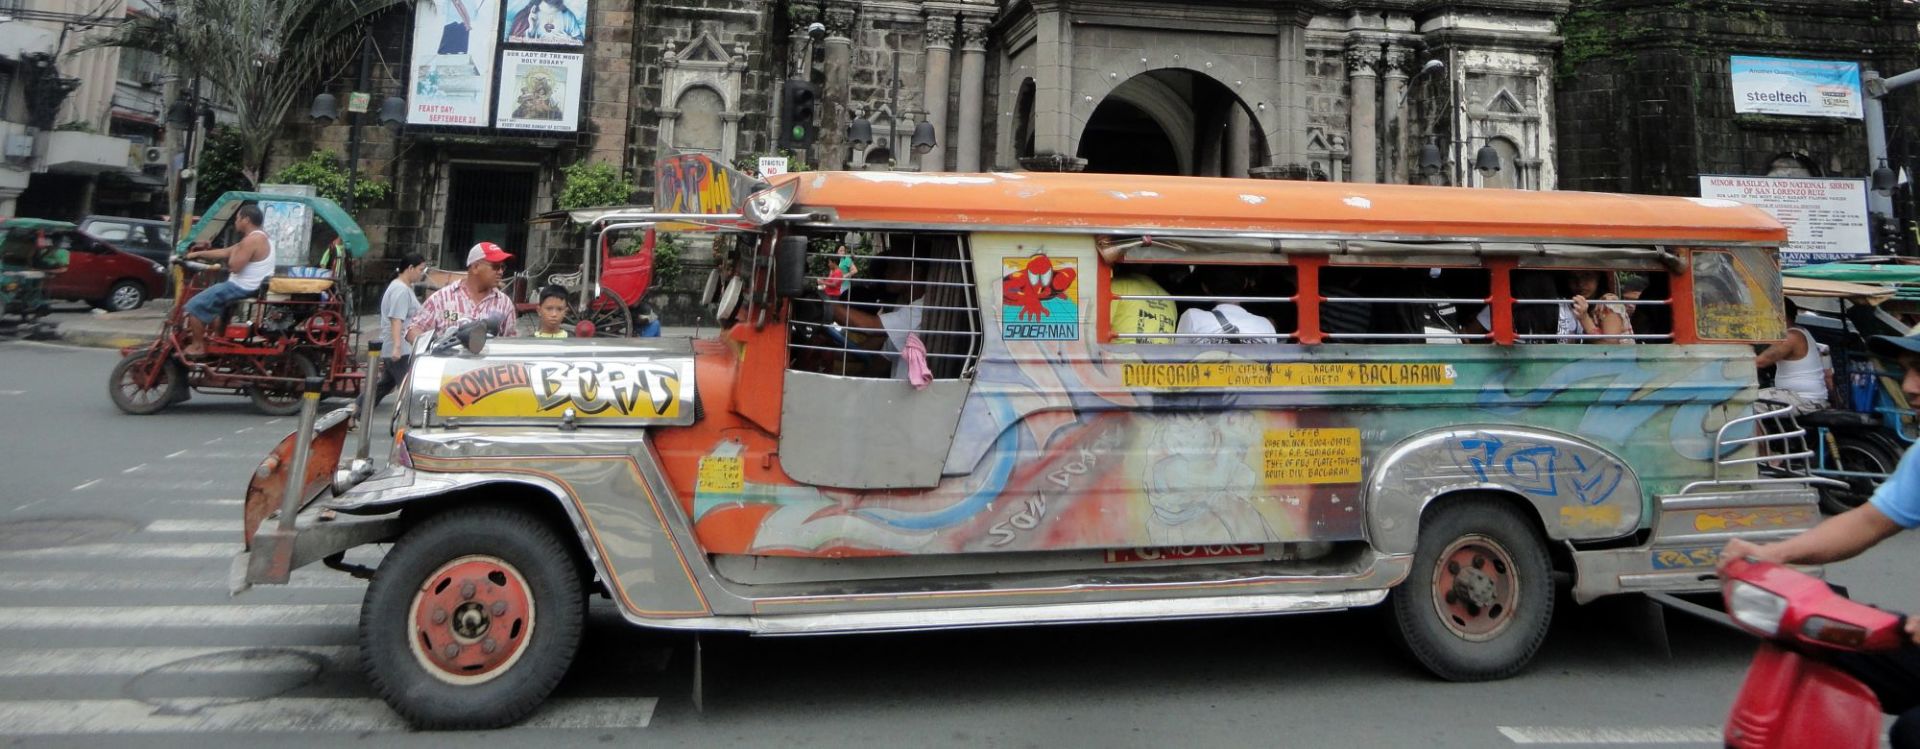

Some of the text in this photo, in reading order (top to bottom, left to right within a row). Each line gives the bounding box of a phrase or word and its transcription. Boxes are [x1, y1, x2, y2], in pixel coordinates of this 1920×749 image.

[1746, 90, 1807, 103] steeltech
[418, 104, 438, 112] FEAST
[429, 114, 466, 123] SEPTEMBER
[1829, 182, 1855, 190] SHRINE
[1772, 188, 1806, 196] LORENZO
[1004, 324, 1075, 338] SPIDER-MAN
[1124, 364, 1200, 386] DIVISORIA
[1313, 364, 1345, 374] KALAW
[1359, 364, 1442, 385] BACLARAN
[1227, 374, 1340, 385] LAWTON LUNETA
